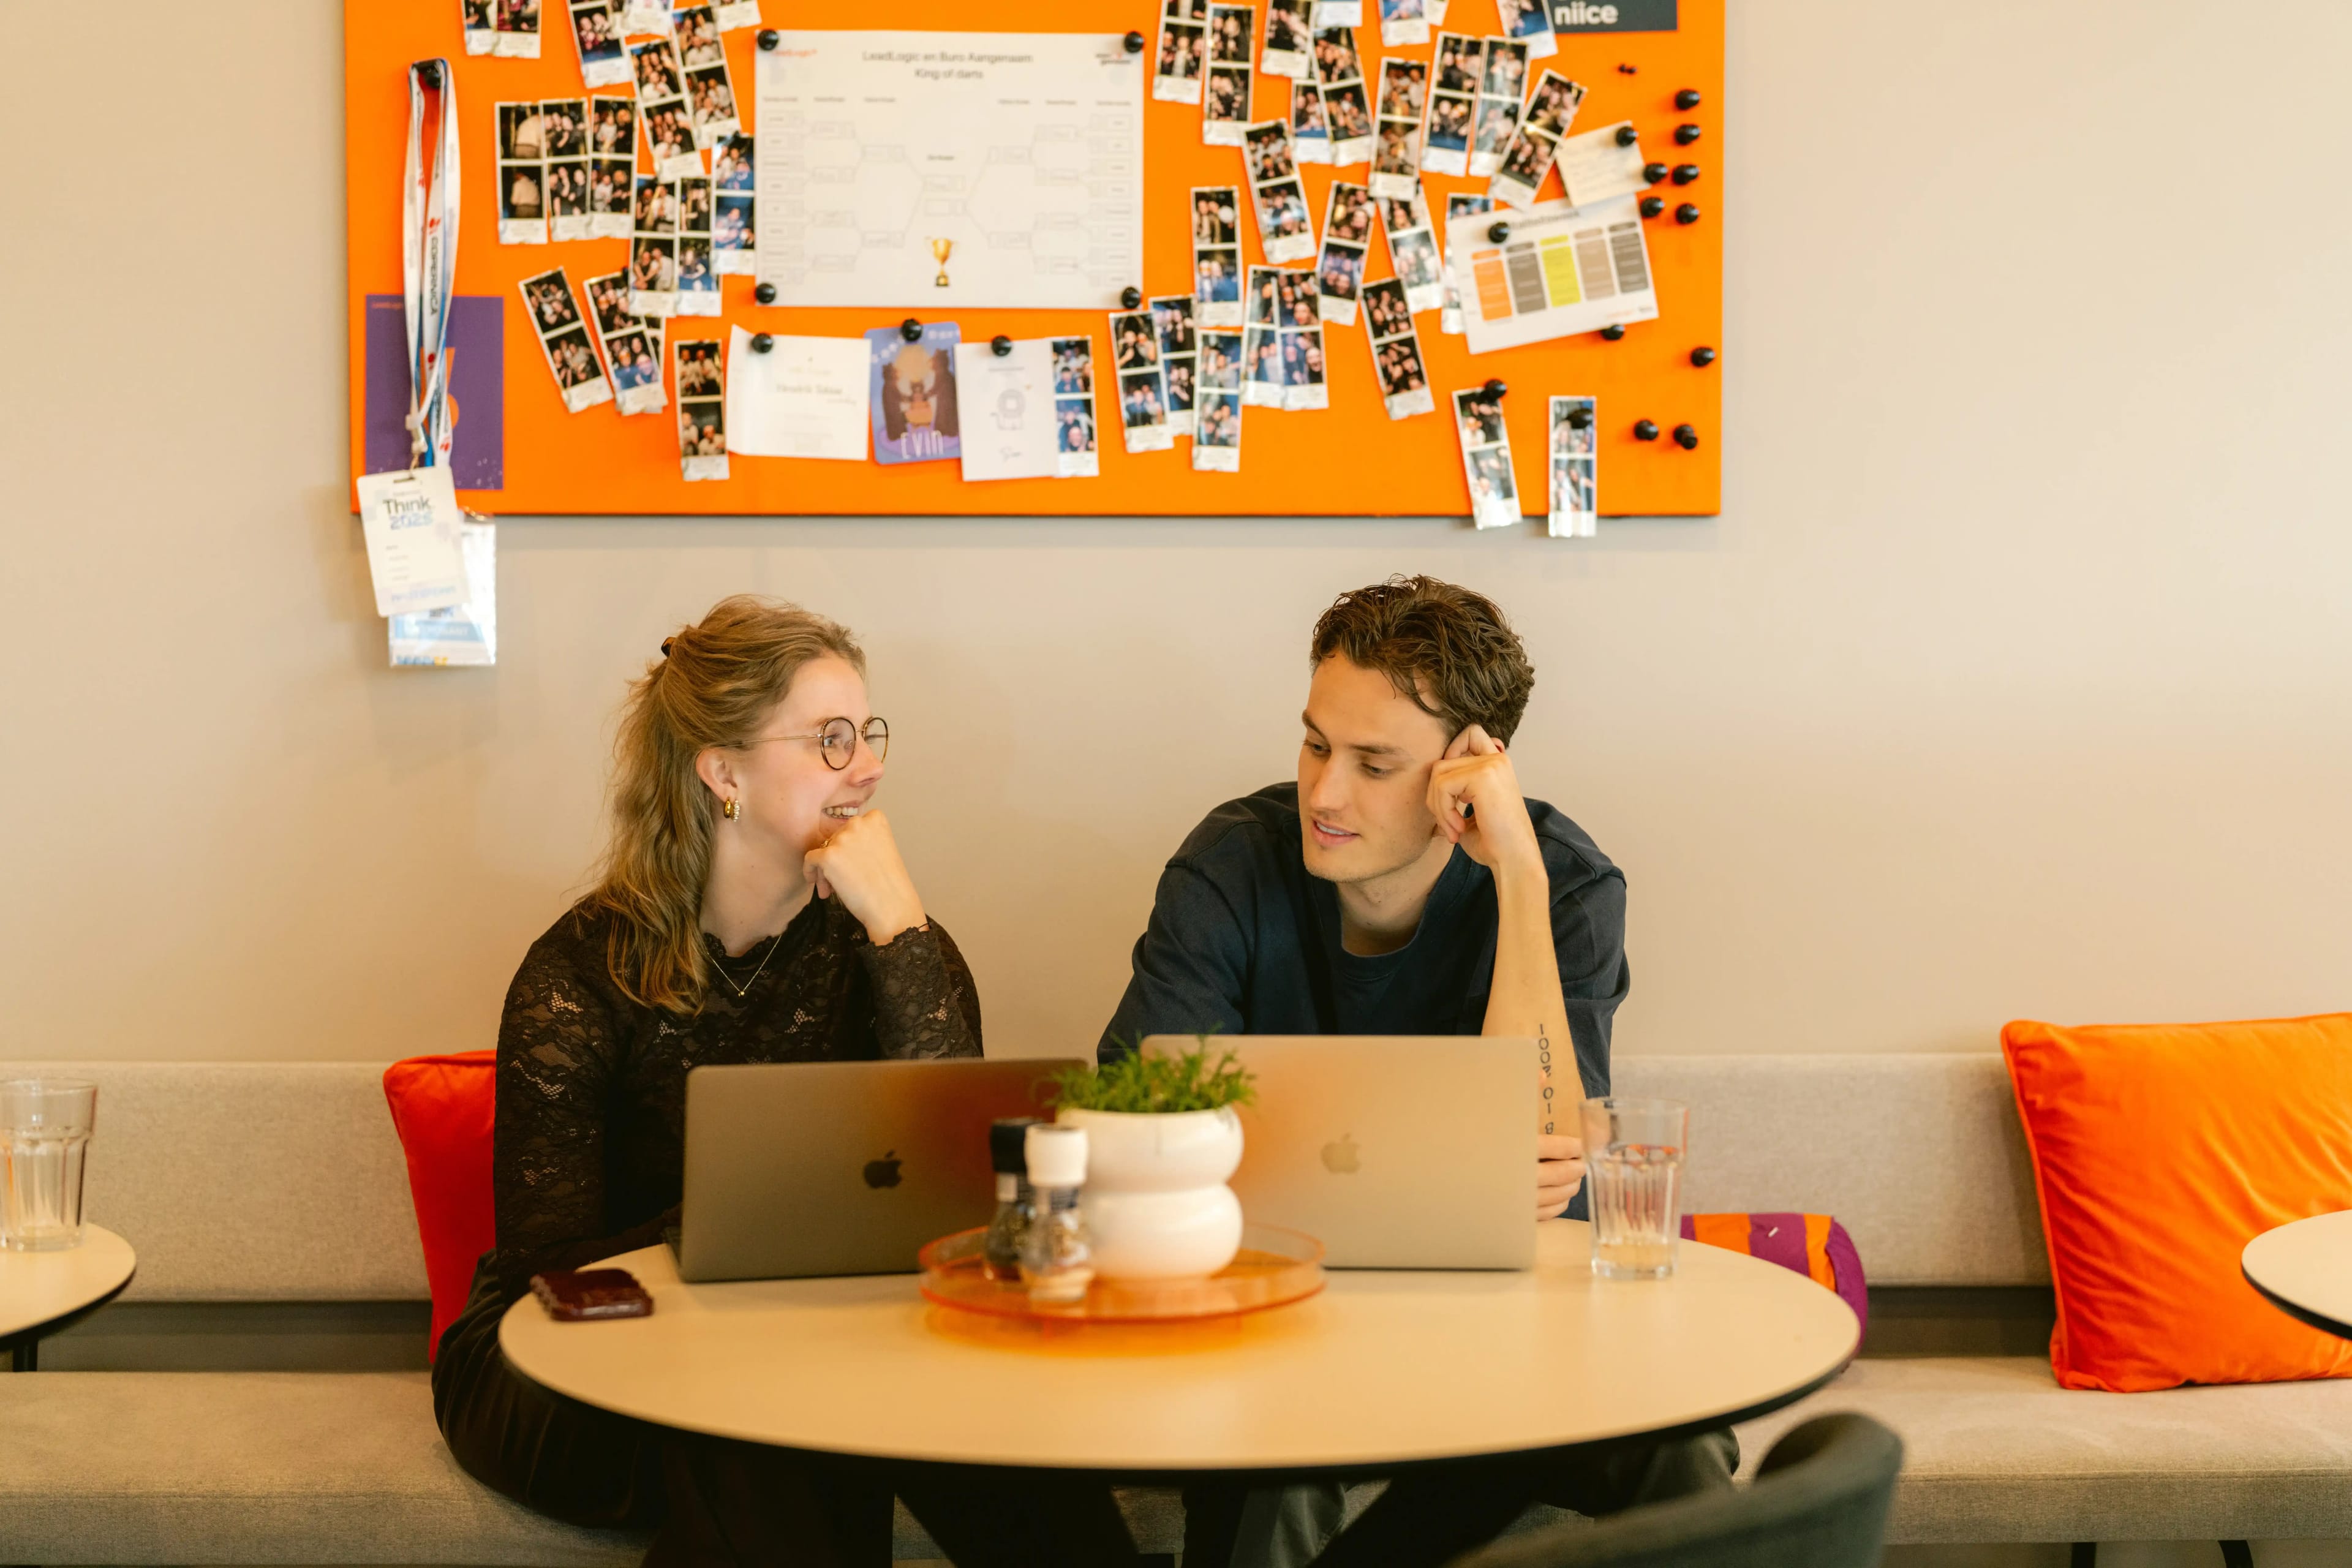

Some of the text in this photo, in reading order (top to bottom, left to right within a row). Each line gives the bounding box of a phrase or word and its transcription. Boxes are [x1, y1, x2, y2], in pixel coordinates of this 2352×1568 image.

[1555, 1, 1618, 25] niice
[914, 69, 984, 80] King of darts
[383, 495, 431, 515] Think
